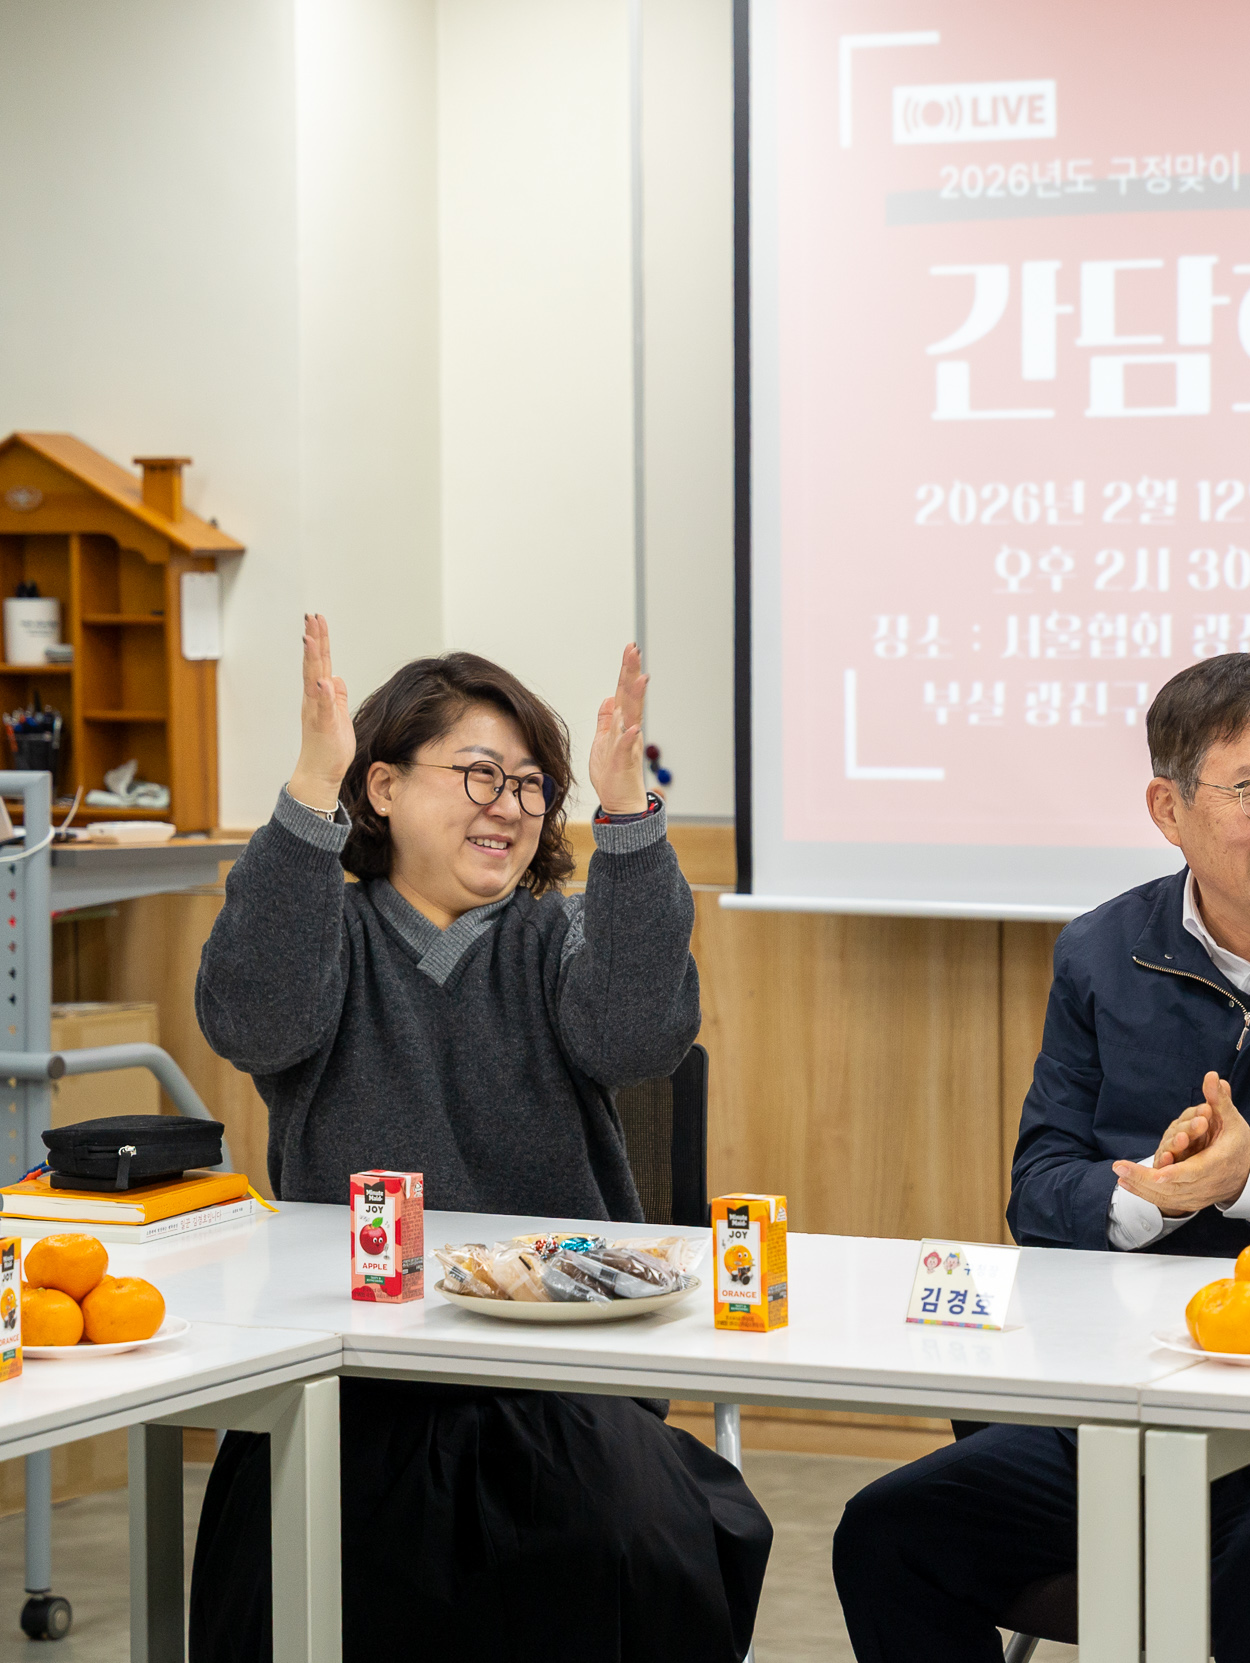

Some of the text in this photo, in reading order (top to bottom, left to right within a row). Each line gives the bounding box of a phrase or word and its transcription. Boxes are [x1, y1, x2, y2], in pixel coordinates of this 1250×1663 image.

[970, 95, 1046, 127] LIVE
[939, 157, 1097, 200] 2026년도
[1106, 151, 1240, 195] 구정맞이
[915, 478, 1086, 526] 2026년
[1102, 475, 1178, 525] 2월
[995, 544, 1076, 593] 오후
[1094, 546, 1171, 592] 2시
[871, 614, 955, 660] 장소
[1001, 609, 1173, 660] 서울협회
[923, 681, 1005, 725] 부설
[729, 1231, 748, 1239] JOY
[722, 1290, 757, 1298] ORANGE
